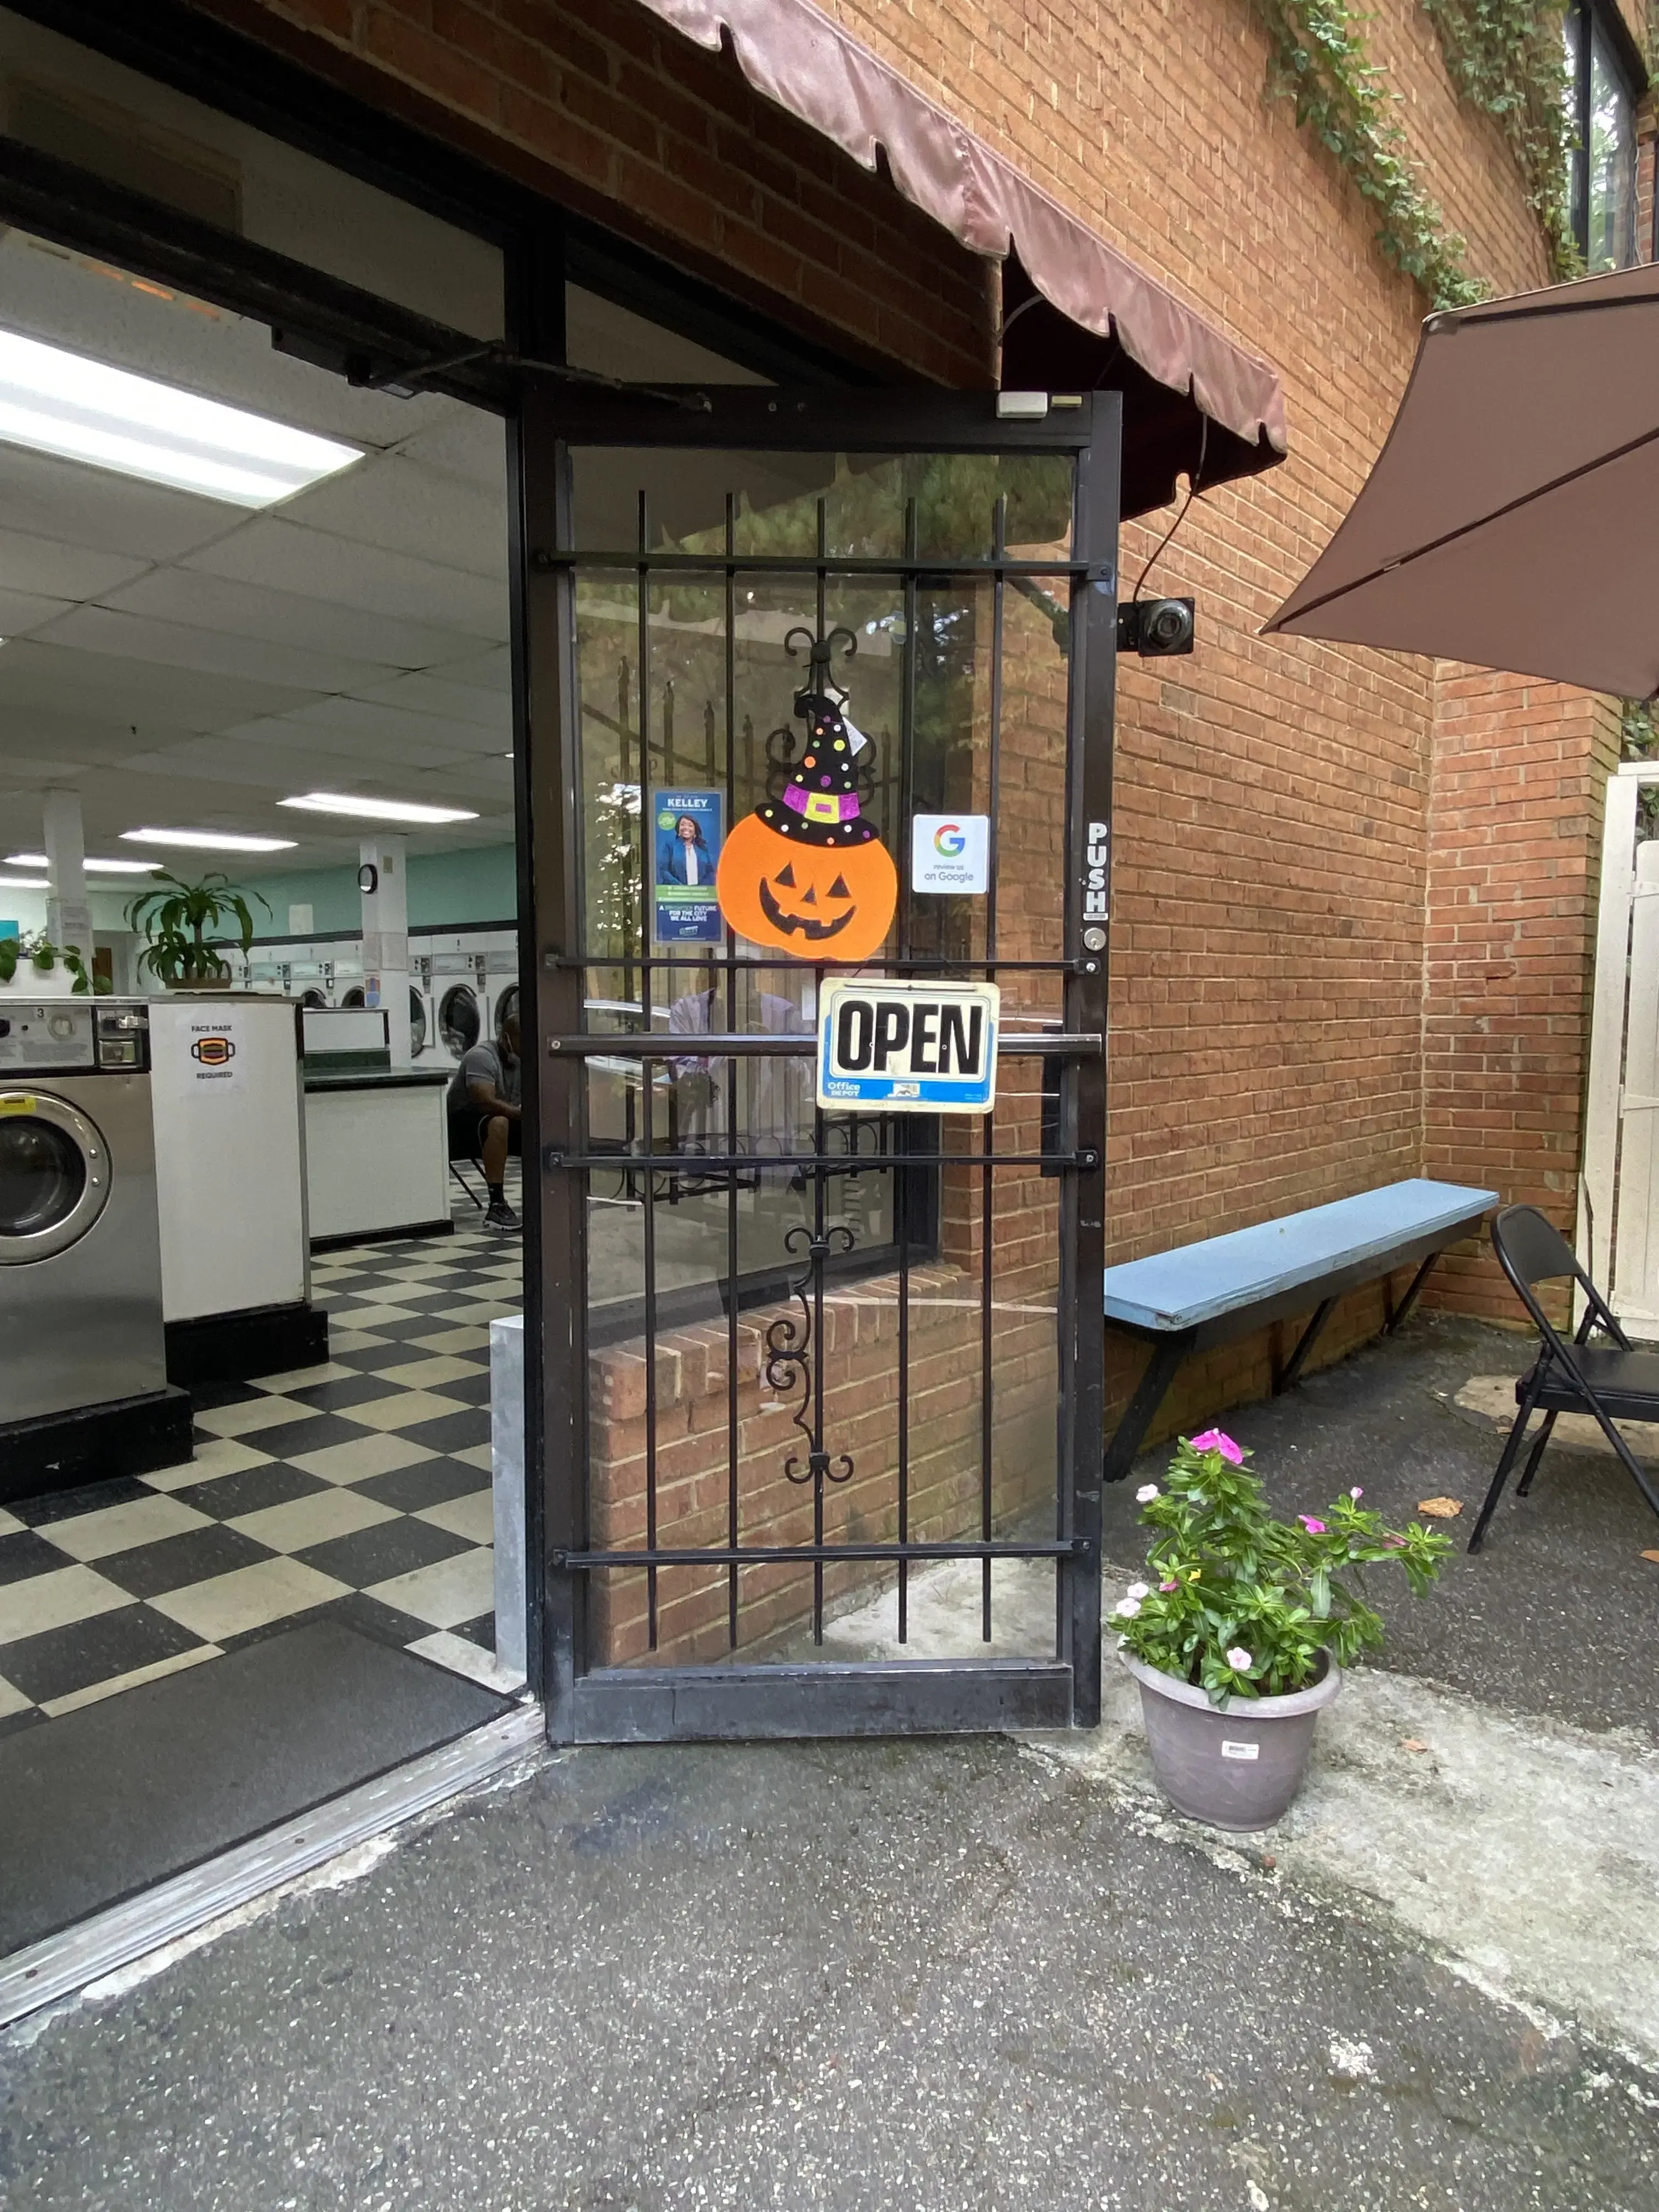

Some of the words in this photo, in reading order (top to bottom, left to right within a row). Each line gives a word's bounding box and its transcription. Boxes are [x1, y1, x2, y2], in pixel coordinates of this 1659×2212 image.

[667, 798, 708, 808] KELLEY
[934, 824, 966, 857] G
[1086, 822, 1108, 912] PUSH
[939, 872, 974, 883] Google
[37, 1008, 44, 1018] 3
[837, 1001, 983, 1074] OPEN
[827, 1081, 861, 1091] Office
